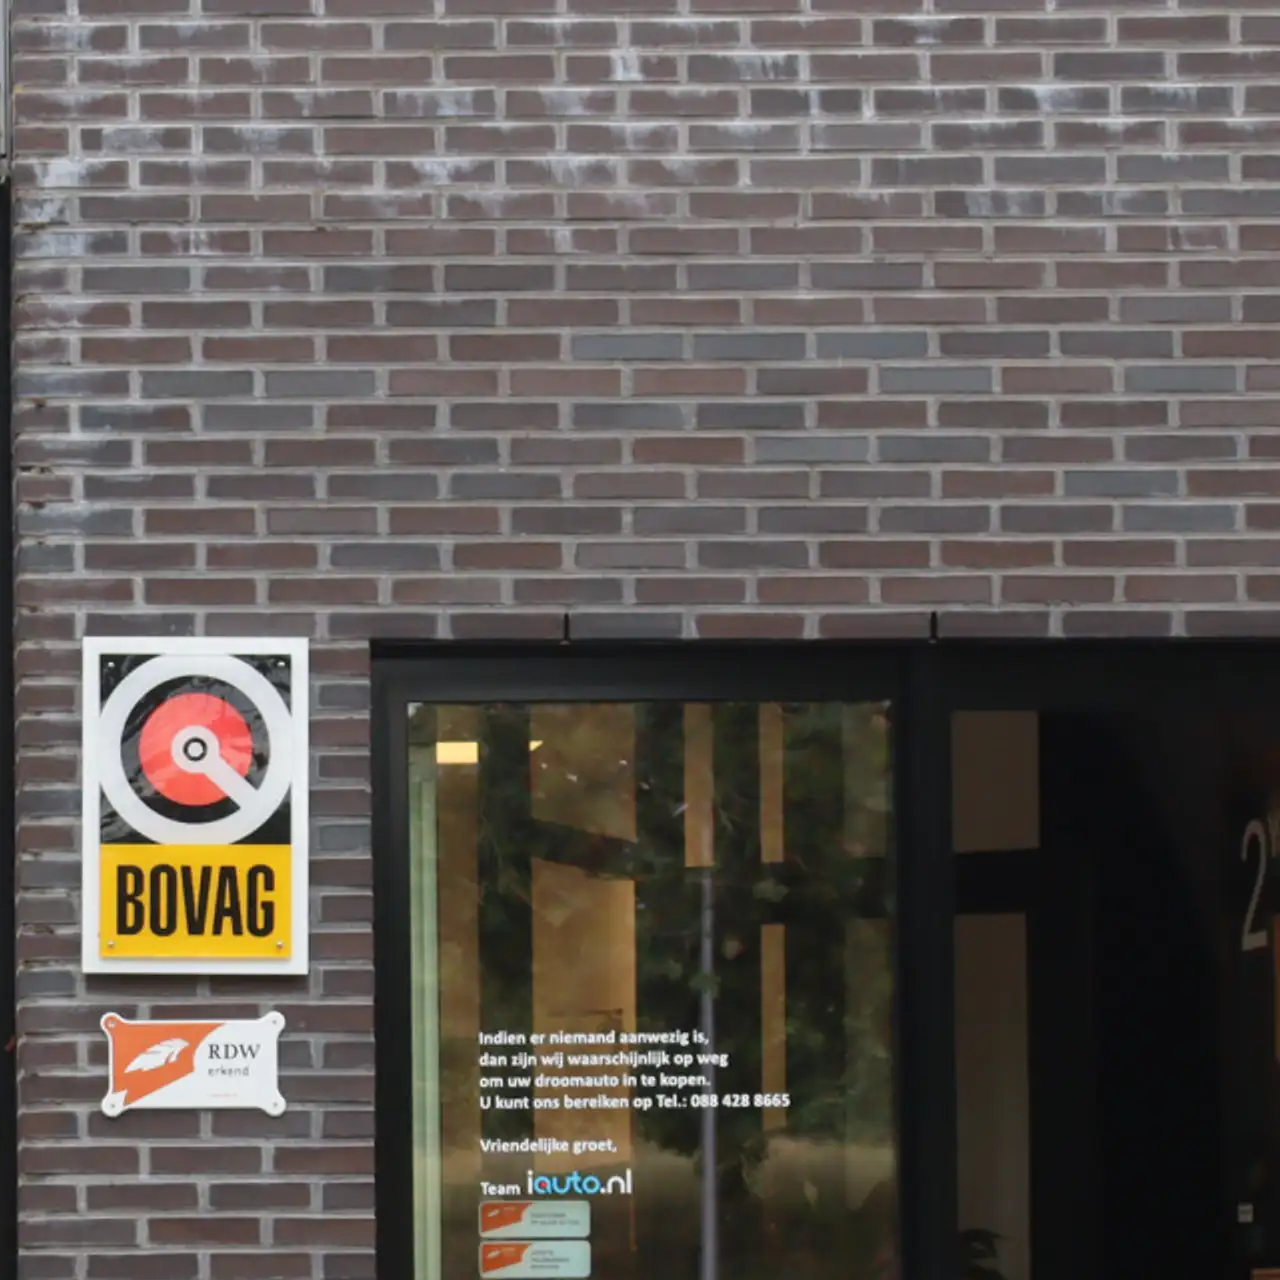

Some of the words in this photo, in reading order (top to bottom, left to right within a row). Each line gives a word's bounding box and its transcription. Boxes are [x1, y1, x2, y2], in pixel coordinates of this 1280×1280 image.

[116, 863, 275, 937] BOVAG
[479, 1031, 526, 1045] Indien
[530, 1034, 544, 1045] er
[550, 1030, 615, 1045] niemand
[620, 1030, 689, 1046] aanwezig
[692, 1030, 709, 1044] is,
[208, 1044, 260, 1059] RDW
[479, 1052, 507, 1066] dan
[512, 1053, 537, 1068] zijn
[541, 1052, 564, 1068] wij
[568, 1051, 670, 1067] waarschijnlijk
[673, 1054, 693, 1066] op
[697, 1054, 729, 1067] weg
[208, 1064, 249, 1077] erkend
[480, 1077, 503, 1087] om
[508, 1077, 531, 1087] uw
[535, 1074, 618, 1087] droomauto
[622, 1074, 637, 1086] in
[641, 1075, 656, 1086] te
[660, 1072, 711, 1089] kopen.
[480, 1096, 491, 1109] U
[495, 1095, 529, 1109] kunt
[533, 1098, 559, 1109] ons
[564, 1095, 629, 1109] bereiken
[633, 1098, 652, 1110] op
[656, 1095, 687, 1107] Tel.:
[691, 1095, 718, 1107] 088
[722, 1095, 749, 1107] 428
[754, 1094, 790, 1107] 8665
[480, 1138, 569, 1155] Vriendelijke
[573, 1139, 617, 1155] groet,
[480, 1182, 520, 1195] Team
[527, 1168, 632, 1194] iauto.nl
